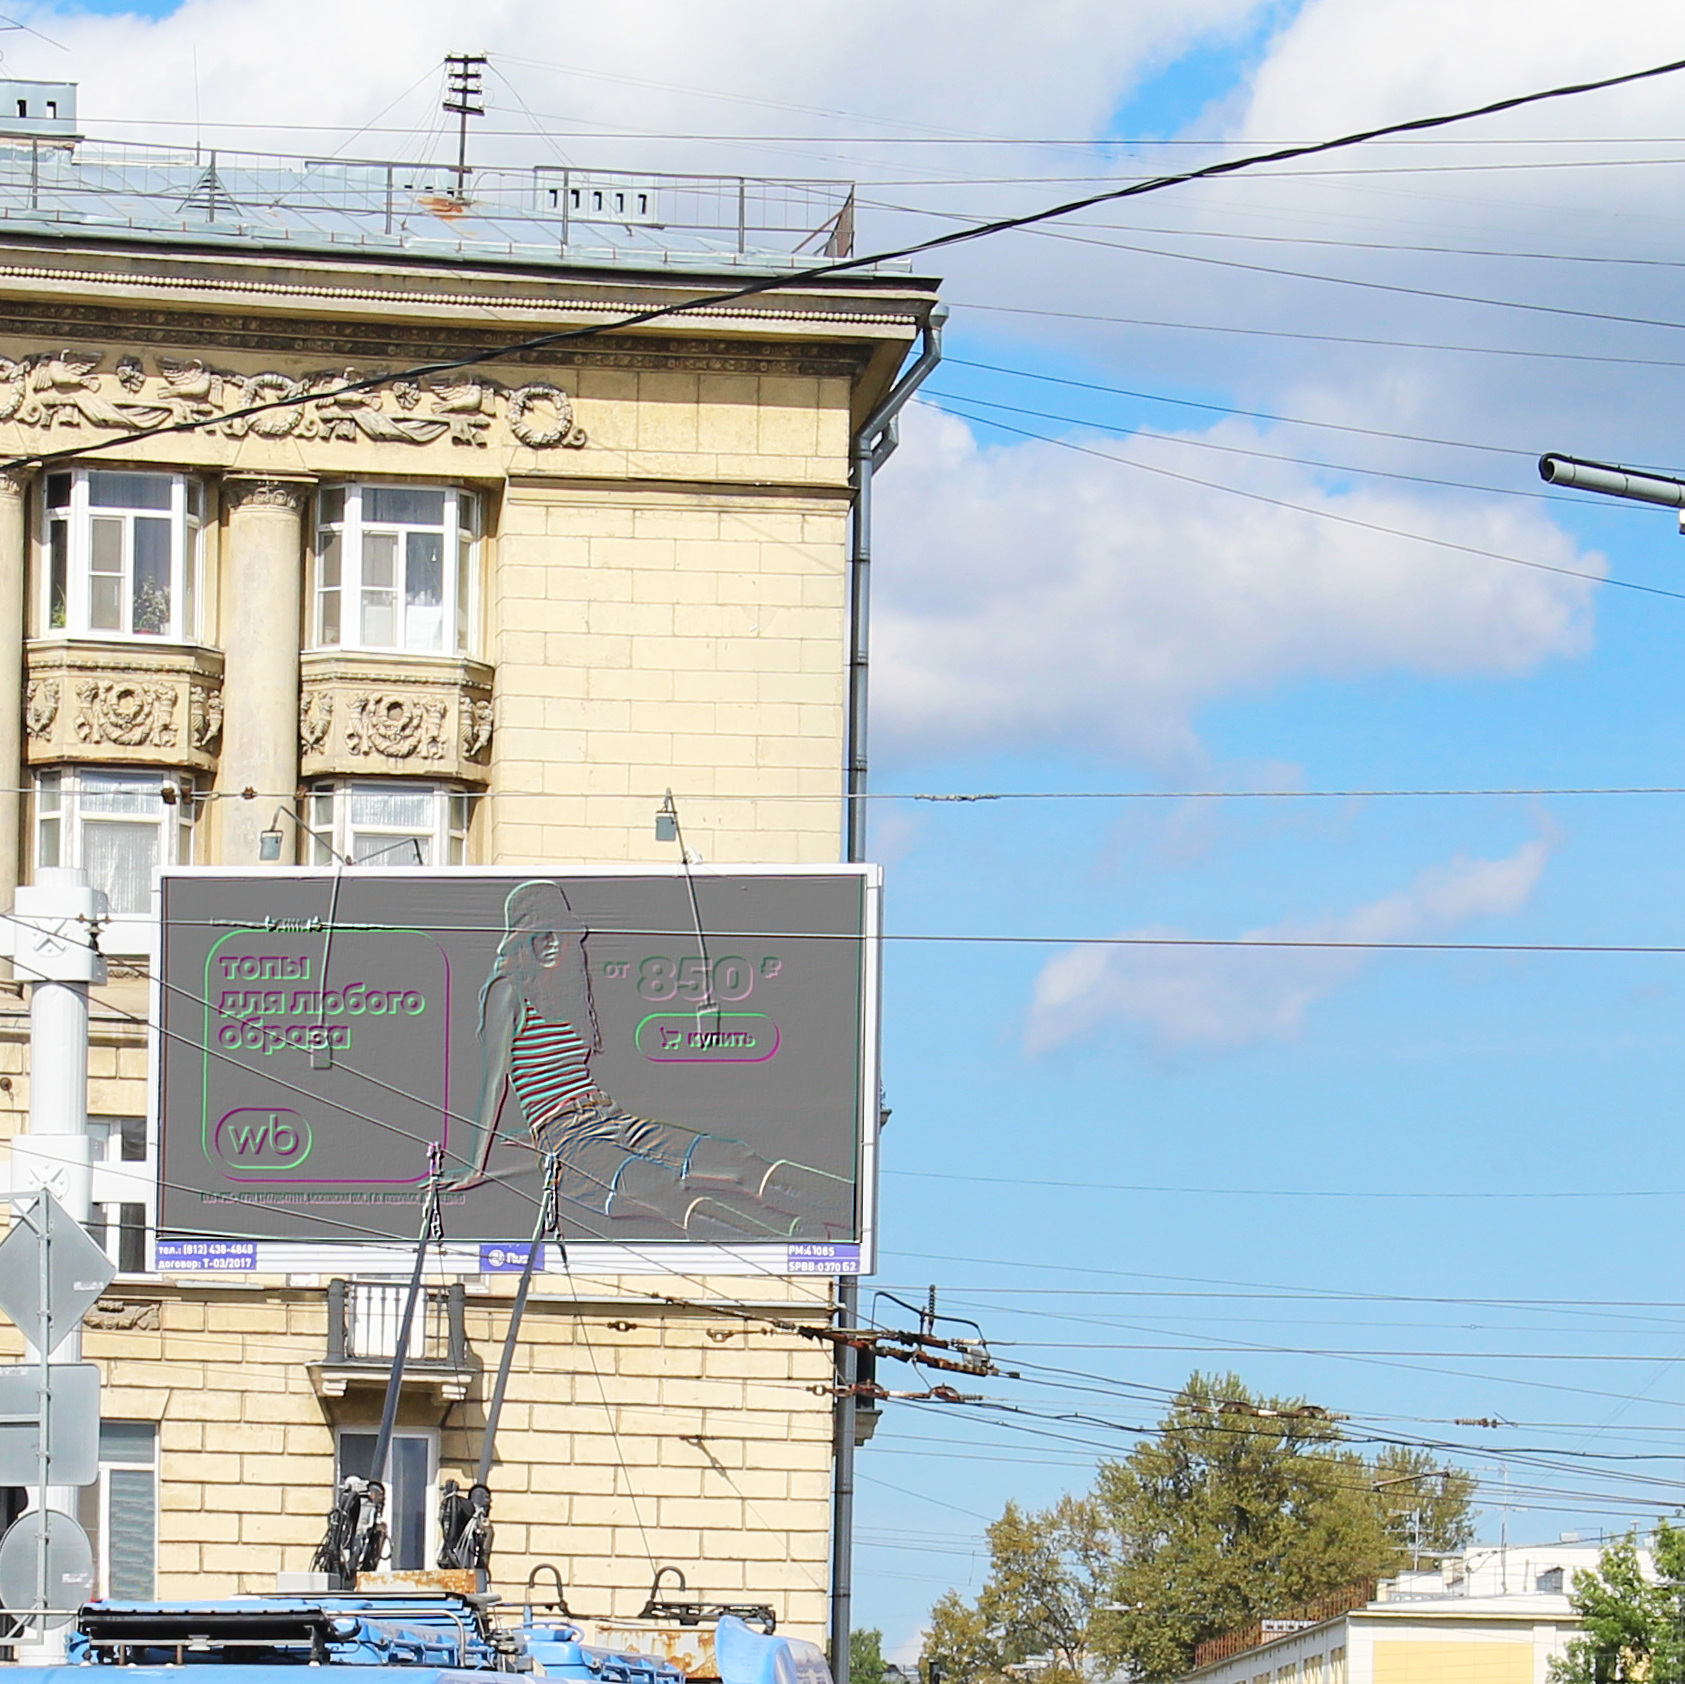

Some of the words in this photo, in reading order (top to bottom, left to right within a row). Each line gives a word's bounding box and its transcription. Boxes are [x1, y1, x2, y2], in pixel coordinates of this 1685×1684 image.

[219, 956, 311, 980] топы
[603, 961, 631, 979] от
[637, 955, 755, 1001] 850
[218, 990, 286, 1018] для
[290, 981, 427, 1015] любого
[218, 1016, 352, 1056] образа
[687, 1031, 757, 1051] купить
[227, 1114, 300, 1156] wb
[158, 1260, 201, 1270] договор:
[202, 1258, 252, 1269] Т-03/2017
[183, 1244, 208, 1256] (812)
[209, 1244, 254, 1255] 438-4848
